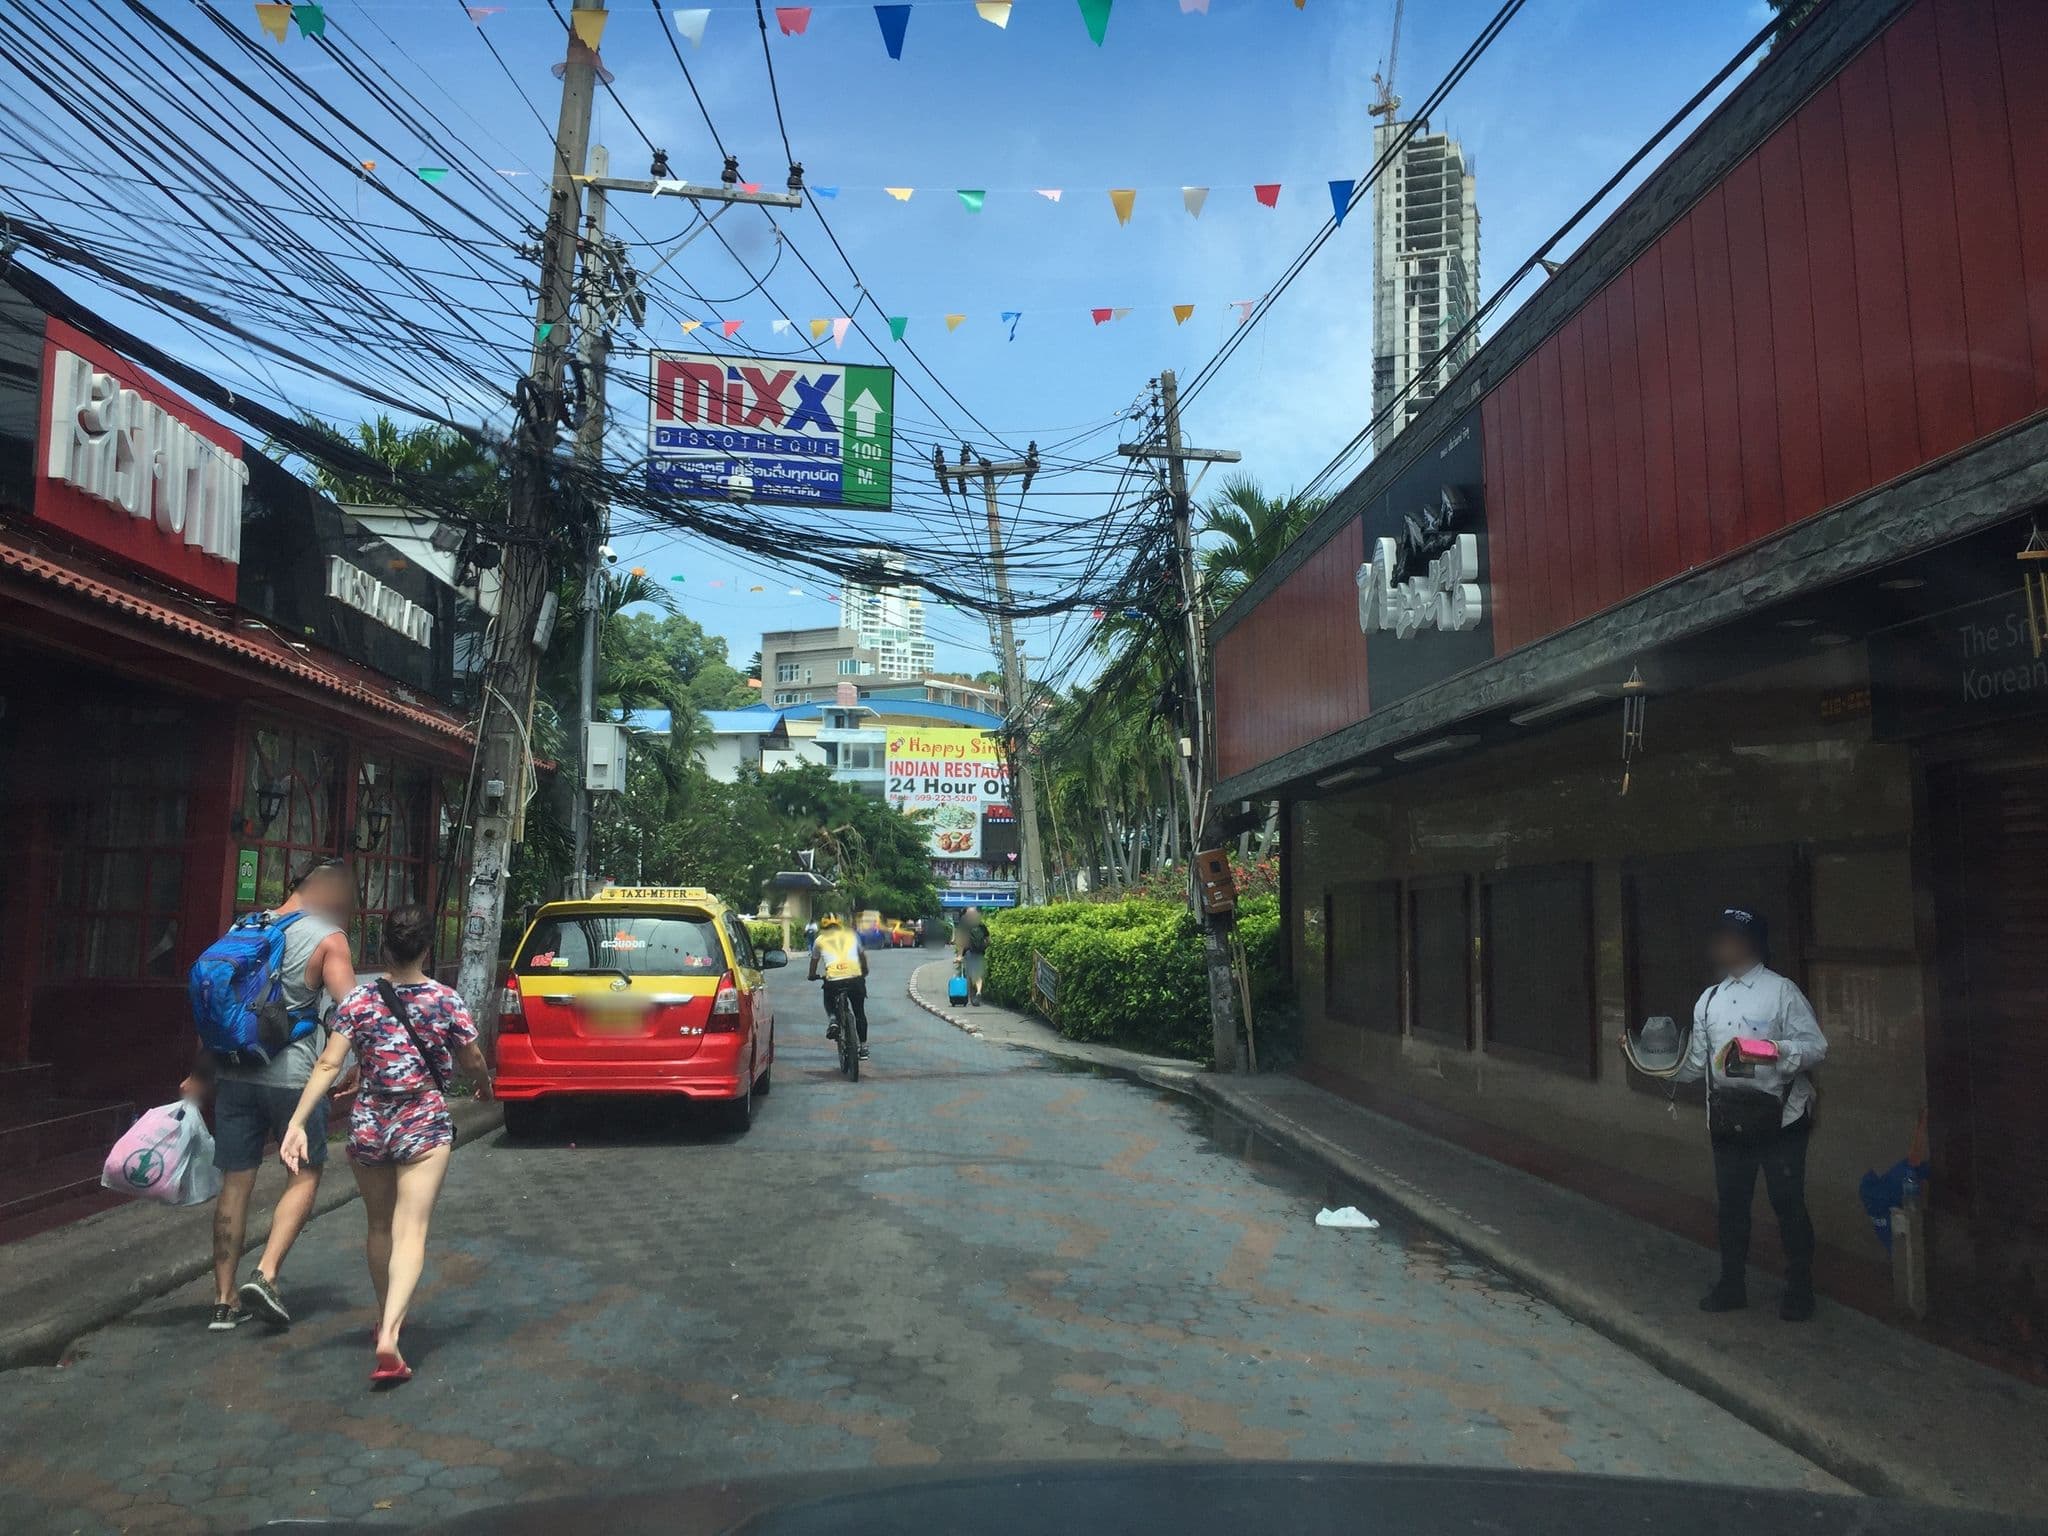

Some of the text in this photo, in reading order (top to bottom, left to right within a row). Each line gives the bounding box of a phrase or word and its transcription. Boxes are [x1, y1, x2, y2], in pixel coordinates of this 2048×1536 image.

[660, 430, 835, 455] DISCOTHEQUE
[851, 442, 882, 461] 100
[1960, 623, 1999, 658] The
[1962, 662, 2048, 702] Korean
[909, 737, 965, 758] Happy
[890, 761, 939, 777] INDIAN
[890, 778, 1010, 799] 24 Hour Op
[620, 889, 687, 898] TAXI-METER
